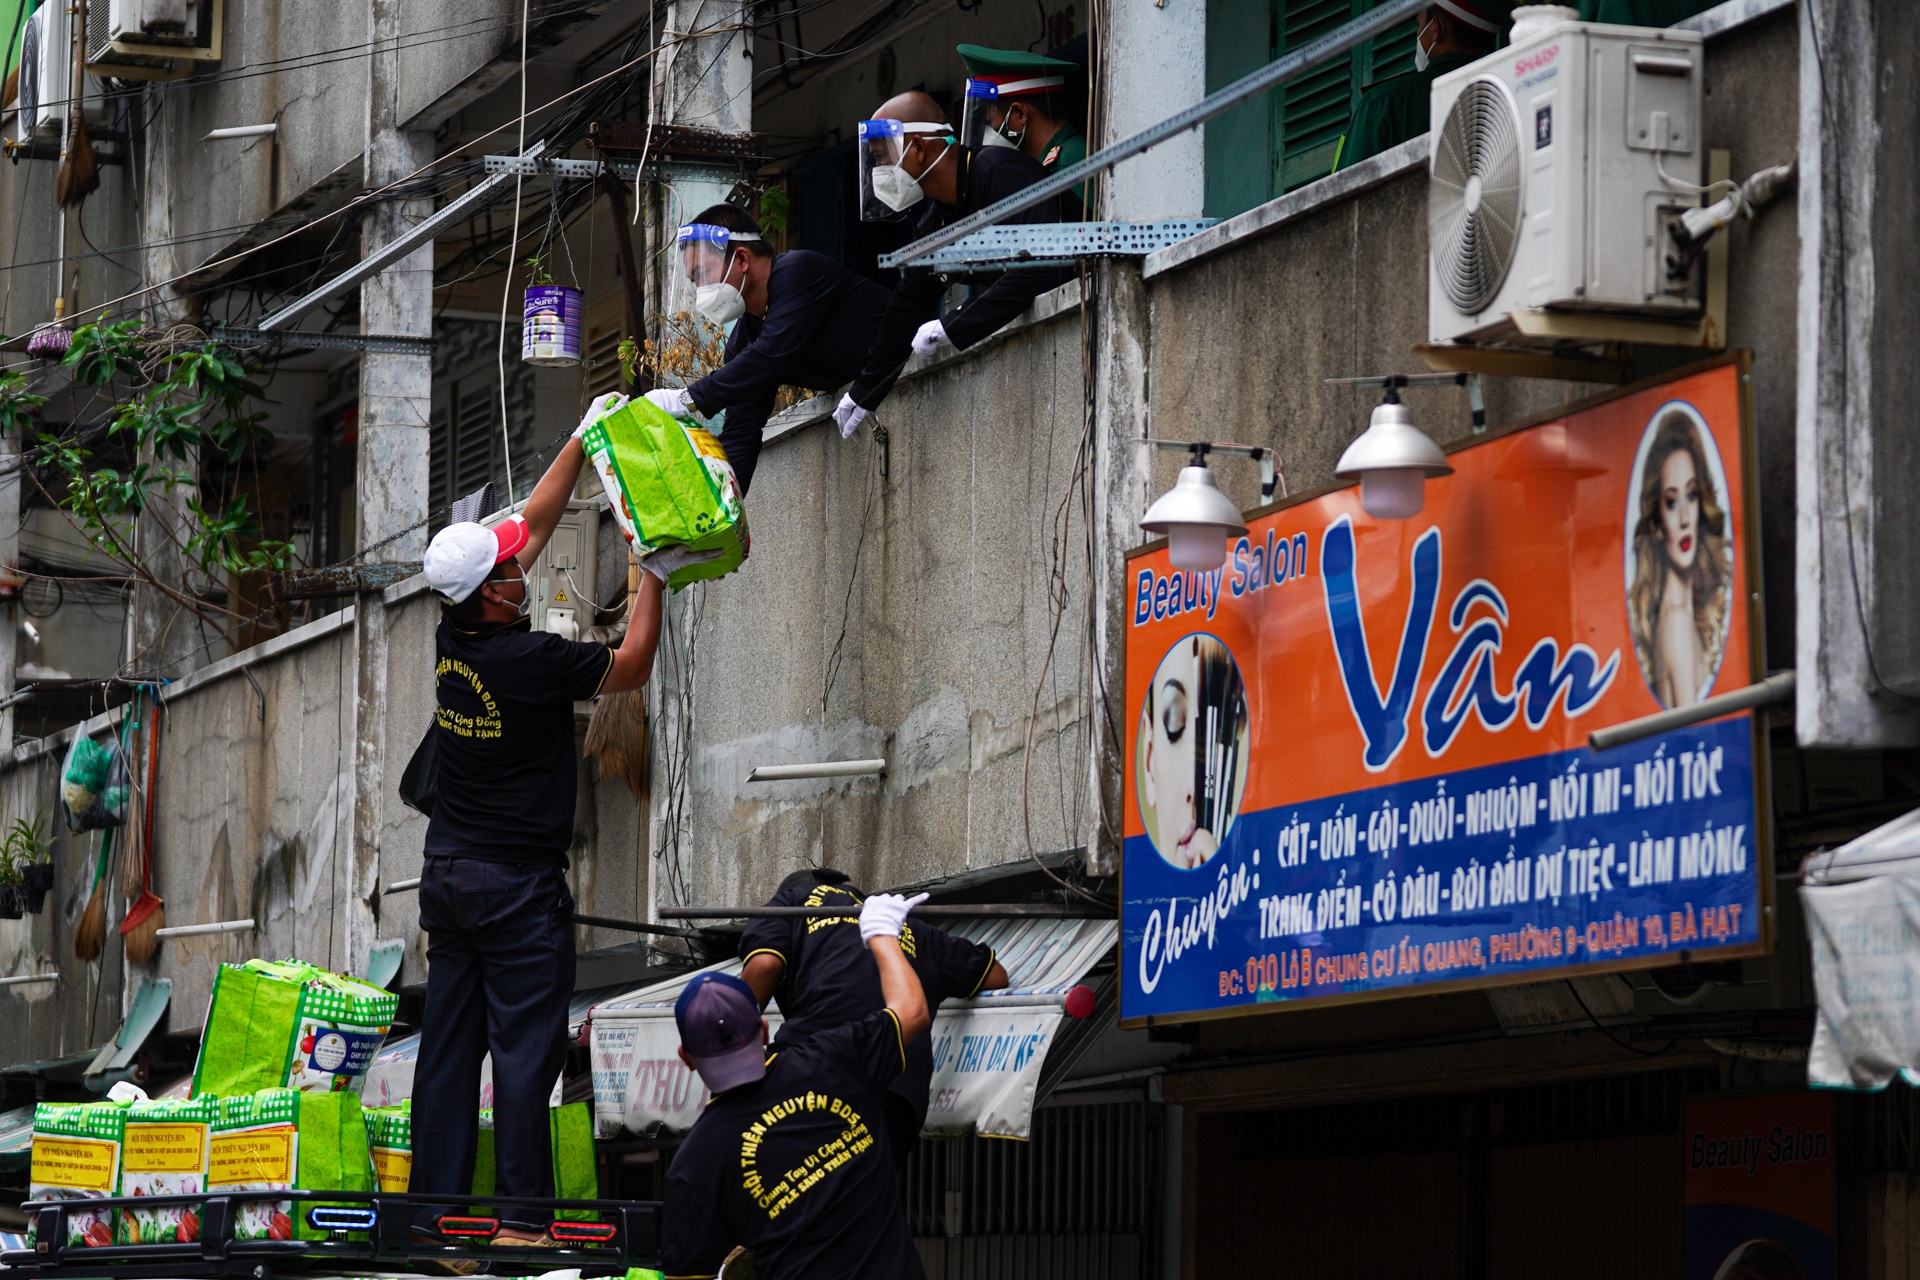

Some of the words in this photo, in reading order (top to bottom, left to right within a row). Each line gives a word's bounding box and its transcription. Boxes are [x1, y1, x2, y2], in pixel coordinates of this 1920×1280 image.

[1514, 44, 1560, 78] SHARP
[1134, 565, 1224, 627] Beauty
[1231, 528, 1308, 598] Salon
[1320, 512, 1621, 772] Vân
[455, 713, 474, 728] Cộng
[475, 715, 502, 730] Đồng
[481, 691, 501, 717] BDS
[1680, 741, 1724, 801] TÓC
[1259, 892, 1312, 939] TRANG
[1535, 845, 1567, 907] DỰ
[1679, 820, 1747, 880] MÓNG
[1219, 968, 1244, 996] ĐC:
[1246, 953, 1278, 993] 010
[1301, 948, 1313, 986] B
[1315, 951, 1368, 985] CHUNG
[1372, 943, 1395, 978] CƯ
[1489, 922, 1562, 963] PHƯỜNG
[1669, 902, 1697, 943] BÀ
[1701, 904, 1743, 942] HẠT
[954, 1035, 994, 1073] THAY
[986, 1025, 1020, 1072] DÂY
[335, 1076, 345, 1084] Big
[761, 1090, 828, 1126] NGUYỆN
[829, 1097, 861, 1125] BDS
[740, 1121, 767, 1168] THIỆN
[758, 1180, 790, 1209] Chung
[783, 1165, 808, 1182] Tay
[817, 1138, 846, 1158] Cộng
[841, 1122, 869, 1143] Đồng
[1690, 1131, 1763, 1176] Beauty
[1767, 1124, 1829, 1164] Salon
[743, 1170, 764, 1199] HỘI
[768, 1188, 800, 1219] APPLE
[797, 1168, 825, 1192] SANG
